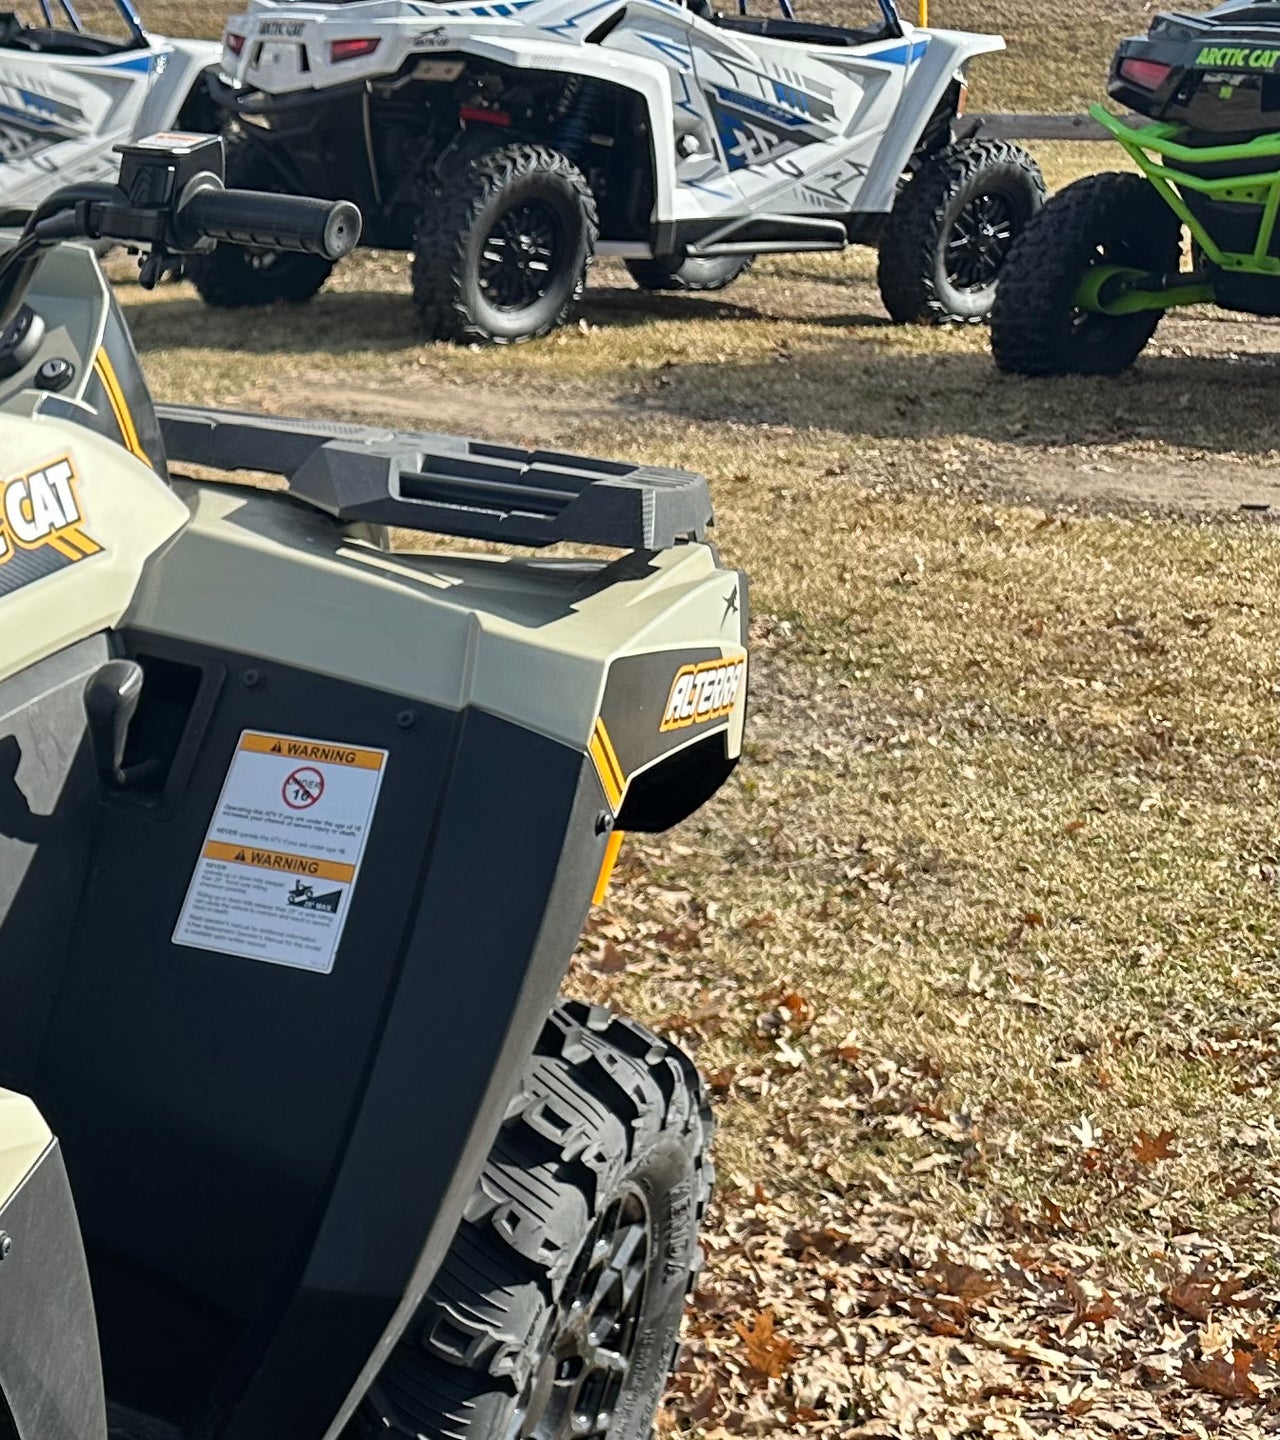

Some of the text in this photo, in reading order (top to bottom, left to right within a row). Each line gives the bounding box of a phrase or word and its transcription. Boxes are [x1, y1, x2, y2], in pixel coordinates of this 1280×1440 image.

[1195, 47, 1280, 68] ARCTIC CAT
[3, 458, 82, 544] CAT
[664, 660, 744, 722] ALTERRA
[286, 742, 357, 764] WARNING
[250, 850, 320, 874] WARNING
